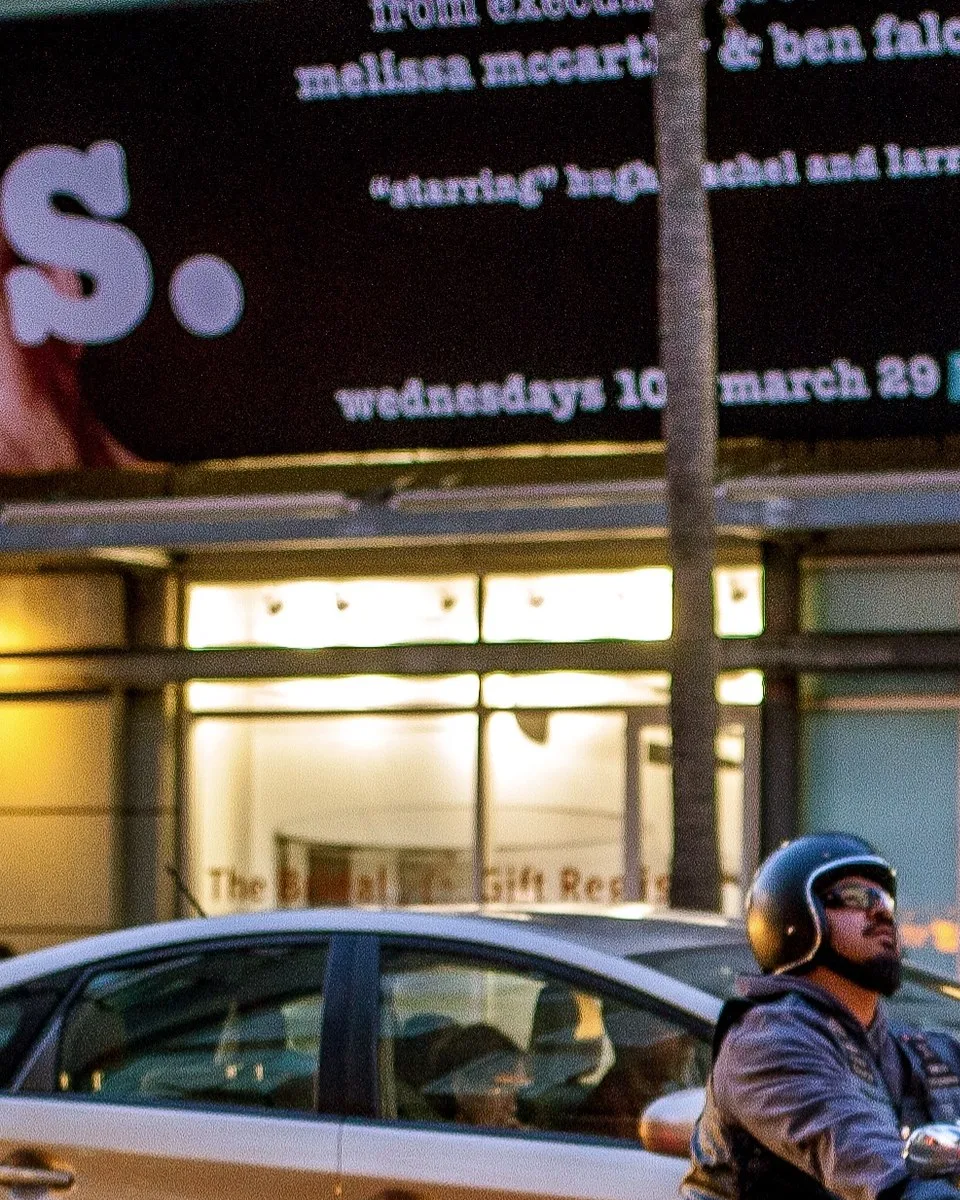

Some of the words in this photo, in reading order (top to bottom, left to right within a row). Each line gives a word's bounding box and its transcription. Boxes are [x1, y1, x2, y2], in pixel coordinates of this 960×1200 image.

[294, 49, 477, 100] melissa
[718, 28, 764, 71] &
[767, 22, 867, 68] ben
[699, 148, 801, 190] achel
[805, 144, 881, 184] and
[333, 371, 605, 423] wednesdays
[717, 357, 872, 405] march
[876, 353, 941, 400] 29
